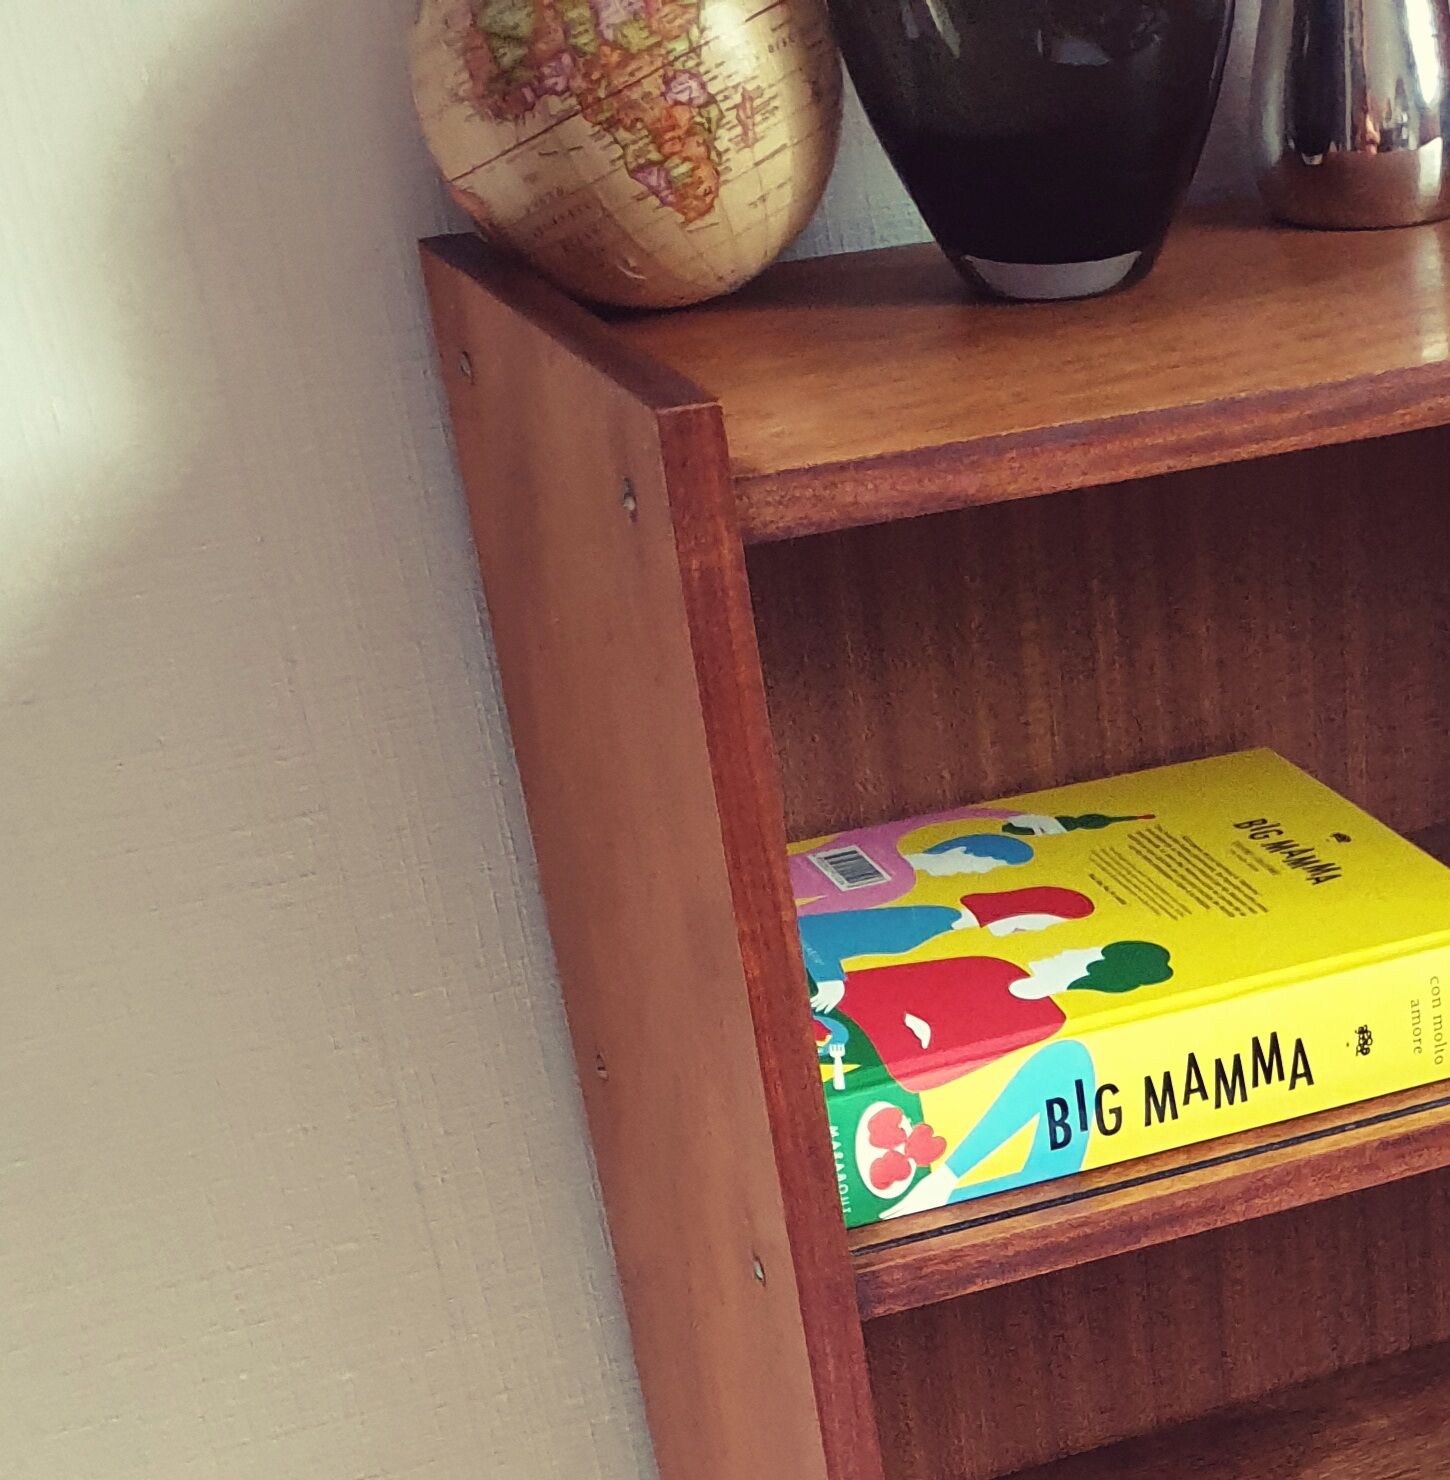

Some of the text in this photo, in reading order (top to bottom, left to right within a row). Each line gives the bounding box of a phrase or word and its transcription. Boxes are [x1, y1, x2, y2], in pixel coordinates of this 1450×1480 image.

[1233, 818, 1283, 840] BIG
[1261, 839, 1342, 885] MAMMA
[1410, 999, 1423, 1055] amore
[1430, 976, 1448, 1065] con molto
[1045, 1031, 1315, 1151] BIG MAMMA
